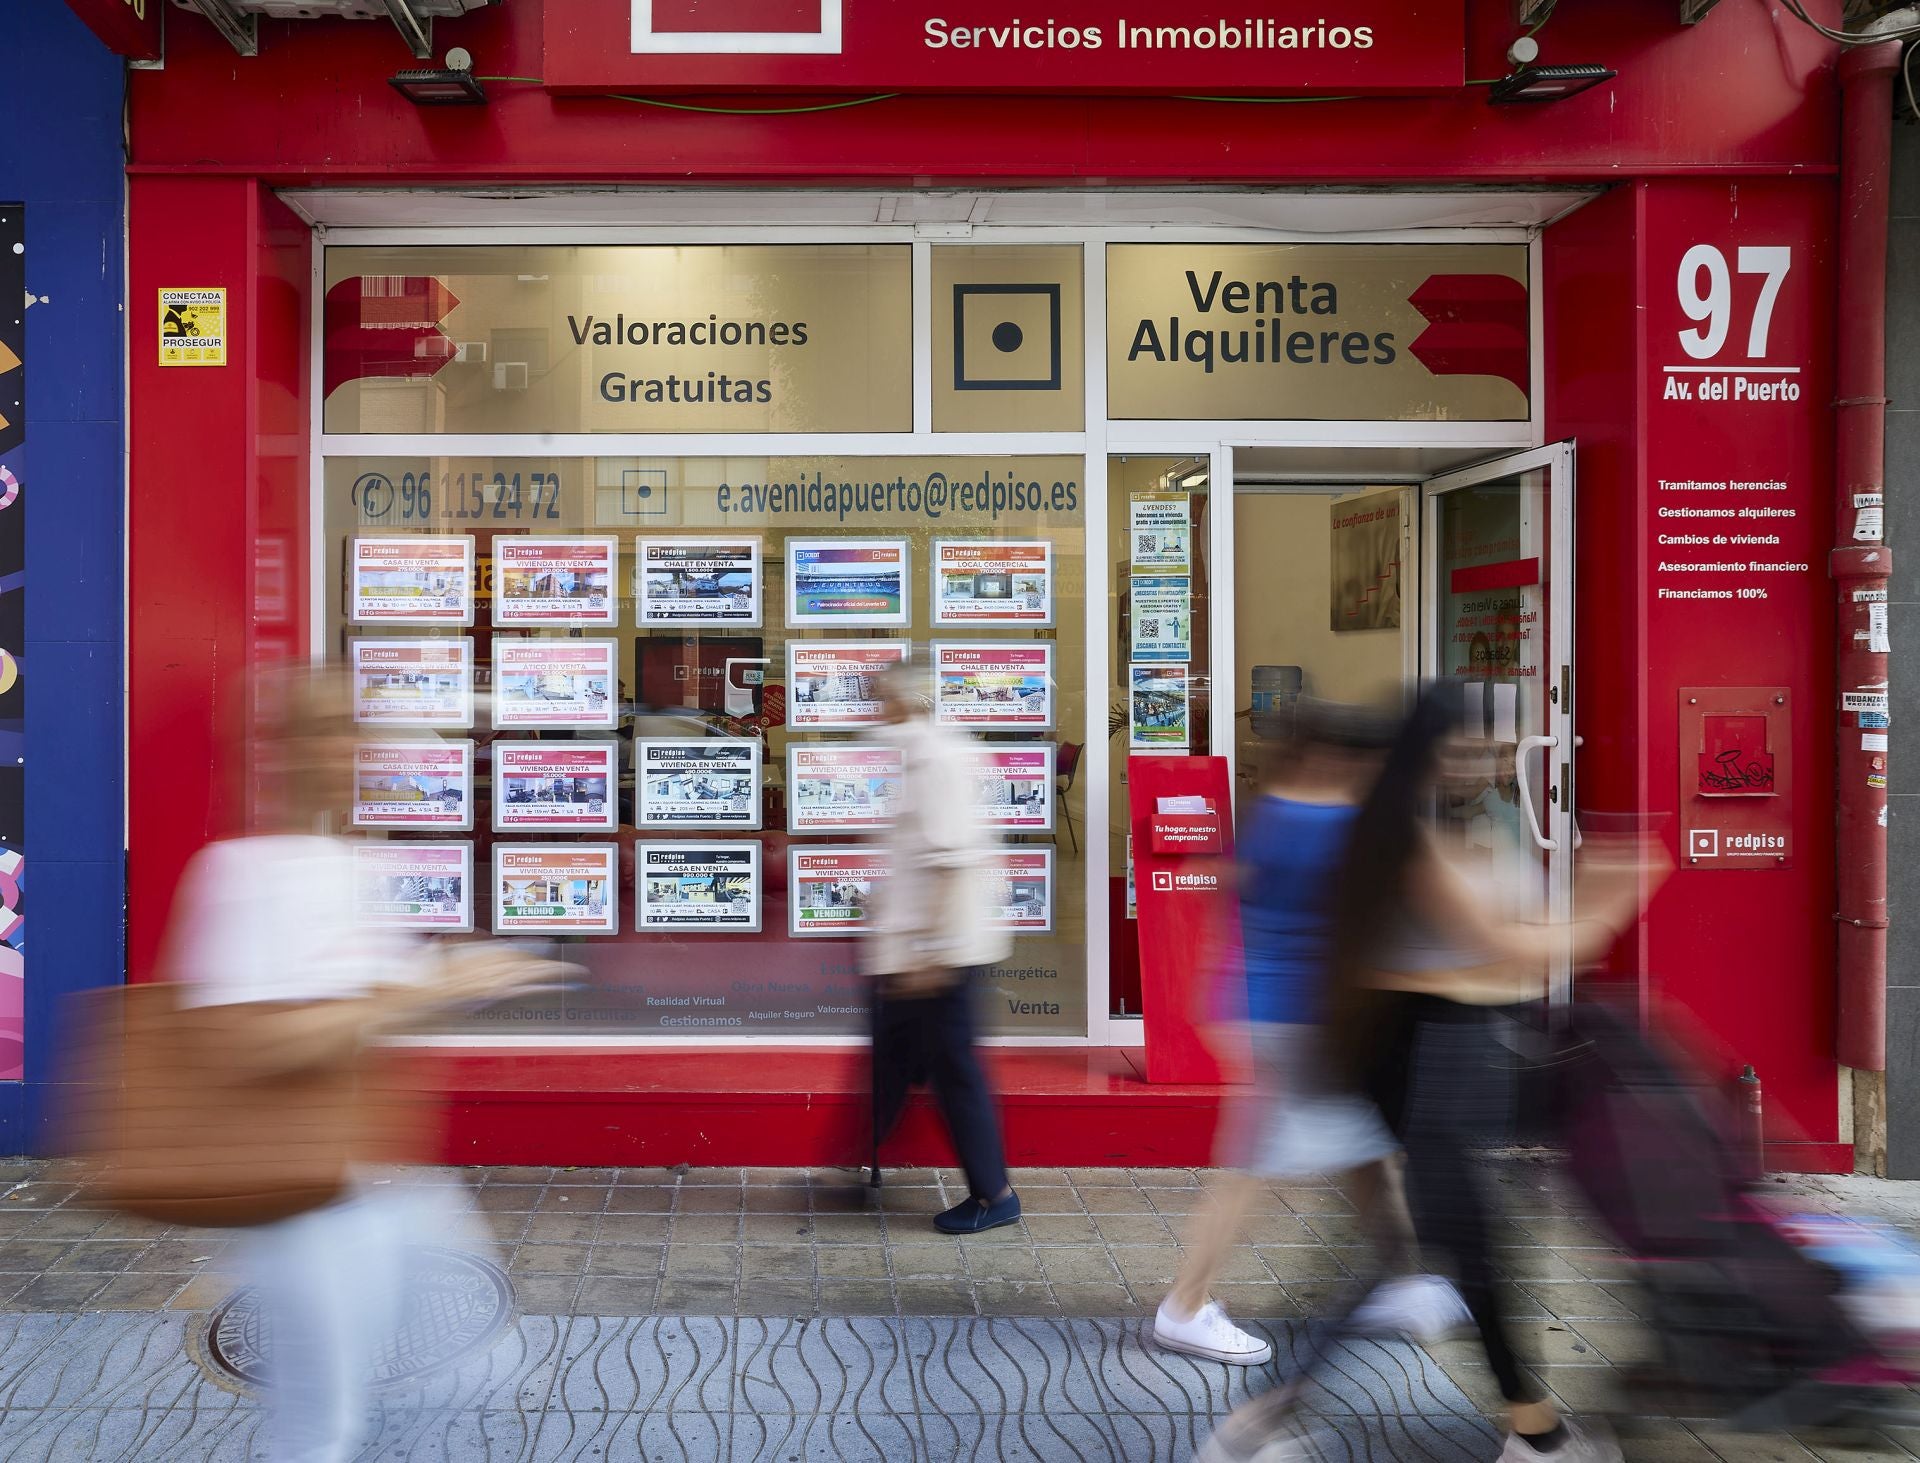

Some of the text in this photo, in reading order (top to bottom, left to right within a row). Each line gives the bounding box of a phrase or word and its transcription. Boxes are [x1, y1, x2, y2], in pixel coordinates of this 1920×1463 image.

[923, 17, 1374, 50] Servicios Inmobiliarios
[1184, 270, 1338, 315] Venta
[1678, 244, 1791, 359] 97
[567, 313, 808, 346] Valoraciones
[163, 339, 221, 347] PROSEGUR
[1127, 317, 1396, 374] Alquileres
[600, 371, 772, 403] Gratuitas
[1664, 376, 1800, 401] Av. del Puerto
[1658, 480, 1787, 490] Tramitamos herencias
[403, 473, 559, 519] 96 115 24 72
[717, 472, 1078, 521] e.avenidapuerto@redpiso.es
[1376, 508, 1385, 521] de
[1658, 507, 1796, 519] Gestionamos alquileres
[1658, 534, 1779, 545] Cambios de vivienda
[1658, 562, 1808, 572] Asesoramiento financiero
[1658, 589, 1767, 599] Financiamos 100%
[1155, 825, 1164, 833] Tu
[1164, 825, 1188, 834] hogar,
[1164, 833, 1209, 843] compromiso
[1726, 834, 1785, 851] redpiso
[1176, 874, 1217, 886] redpiso
[517, 907, 555, 915] VENDIDO
[814, 909, 851, 918] VENDIDO
[990, 967, 1057, 981] Energética
[647, 997, 725, 1007] Realidad Virtual
[1008, 1000, 1060, 1015] Venta
[566, 1008, 638, 1021] Gratuitas
[748, 1010, 815, 1021] Alquiler Seguro
[660, 1015, 742, 1027] Gestionamos
